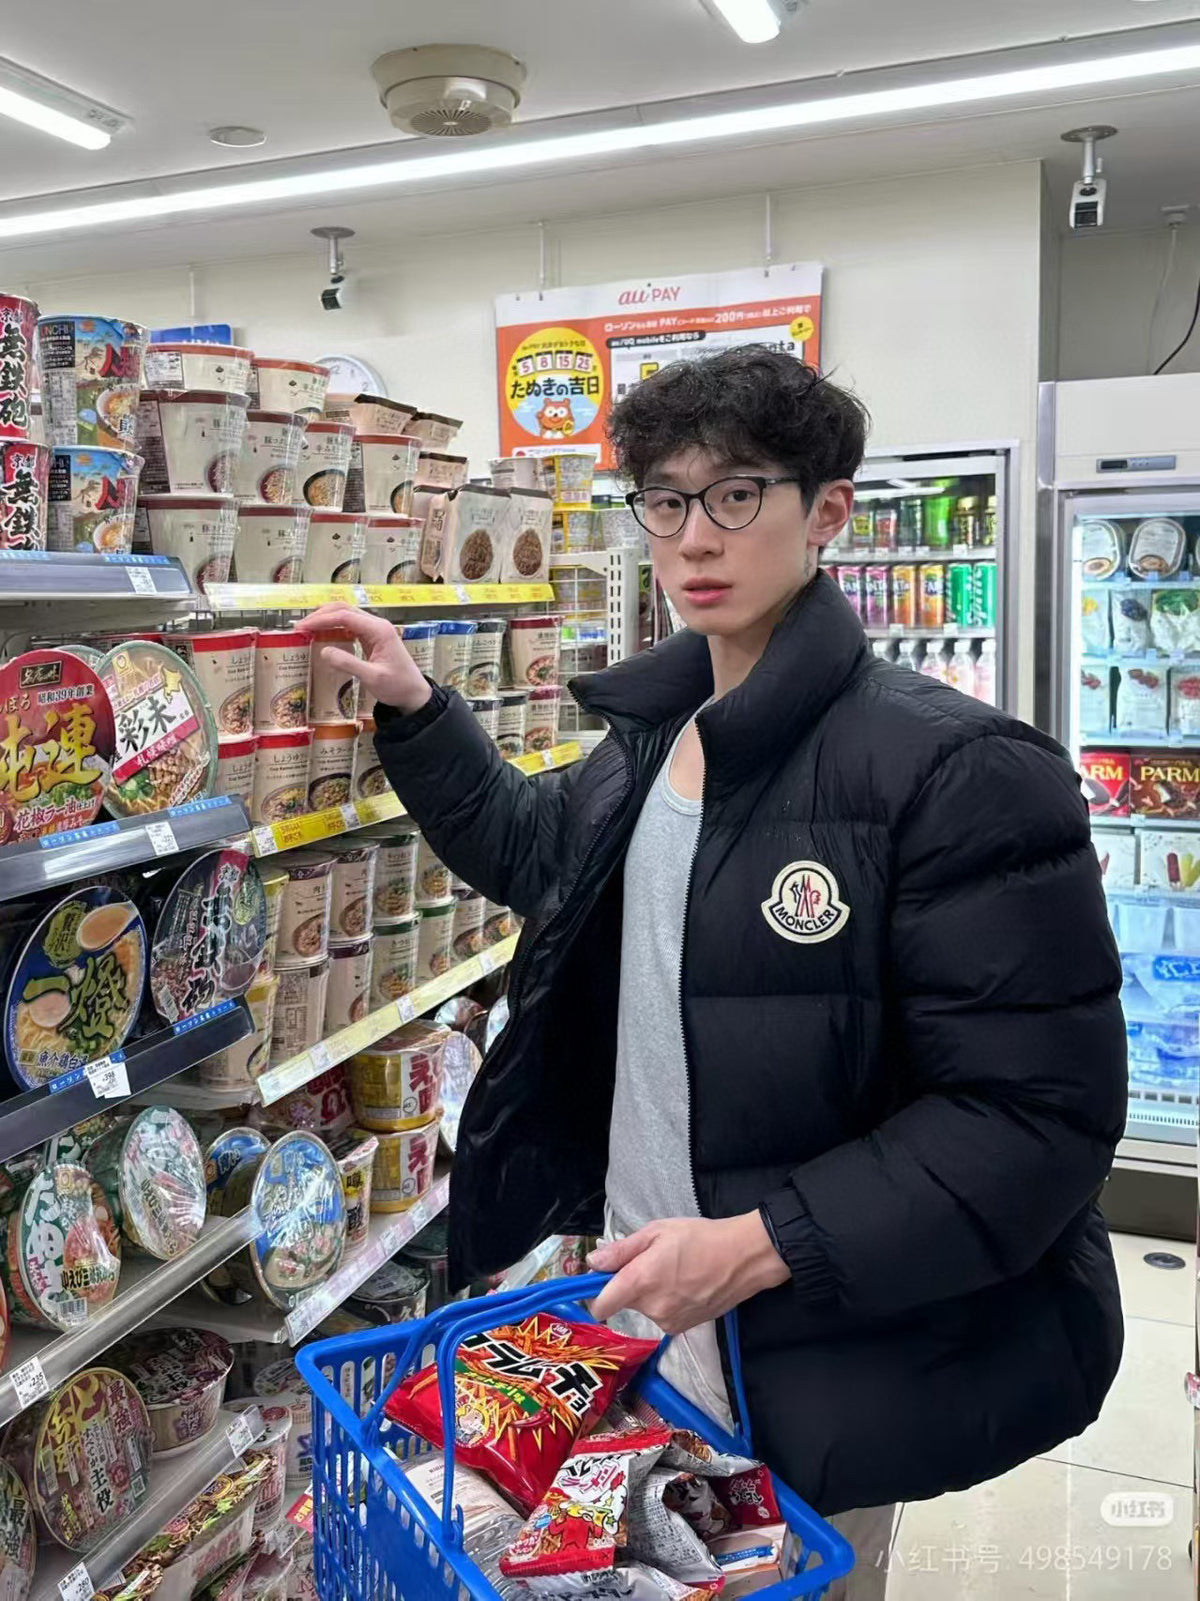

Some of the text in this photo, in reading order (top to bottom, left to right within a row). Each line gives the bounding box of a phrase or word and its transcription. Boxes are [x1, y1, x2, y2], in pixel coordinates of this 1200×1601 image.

[618, 286, 681, 305] au PAY
[521, 361, 531, 374] 5
[540, 356, 549, 368] 8
[559, 355, 570, 367] 15
[577, 357, 590, 370] 25
[510, 376, 600, 399] たぬきの吉日
[38, 685, 94, 705] 昭和39年創業
[117, 695, 177, 754] 彩未
[1080, 762, 1125, 780] ARM
[1140, 765, 1200, 782] PARM
[775, 906, 835, 931] MONCLER
[108, 1380, 133, 1434] 最強
